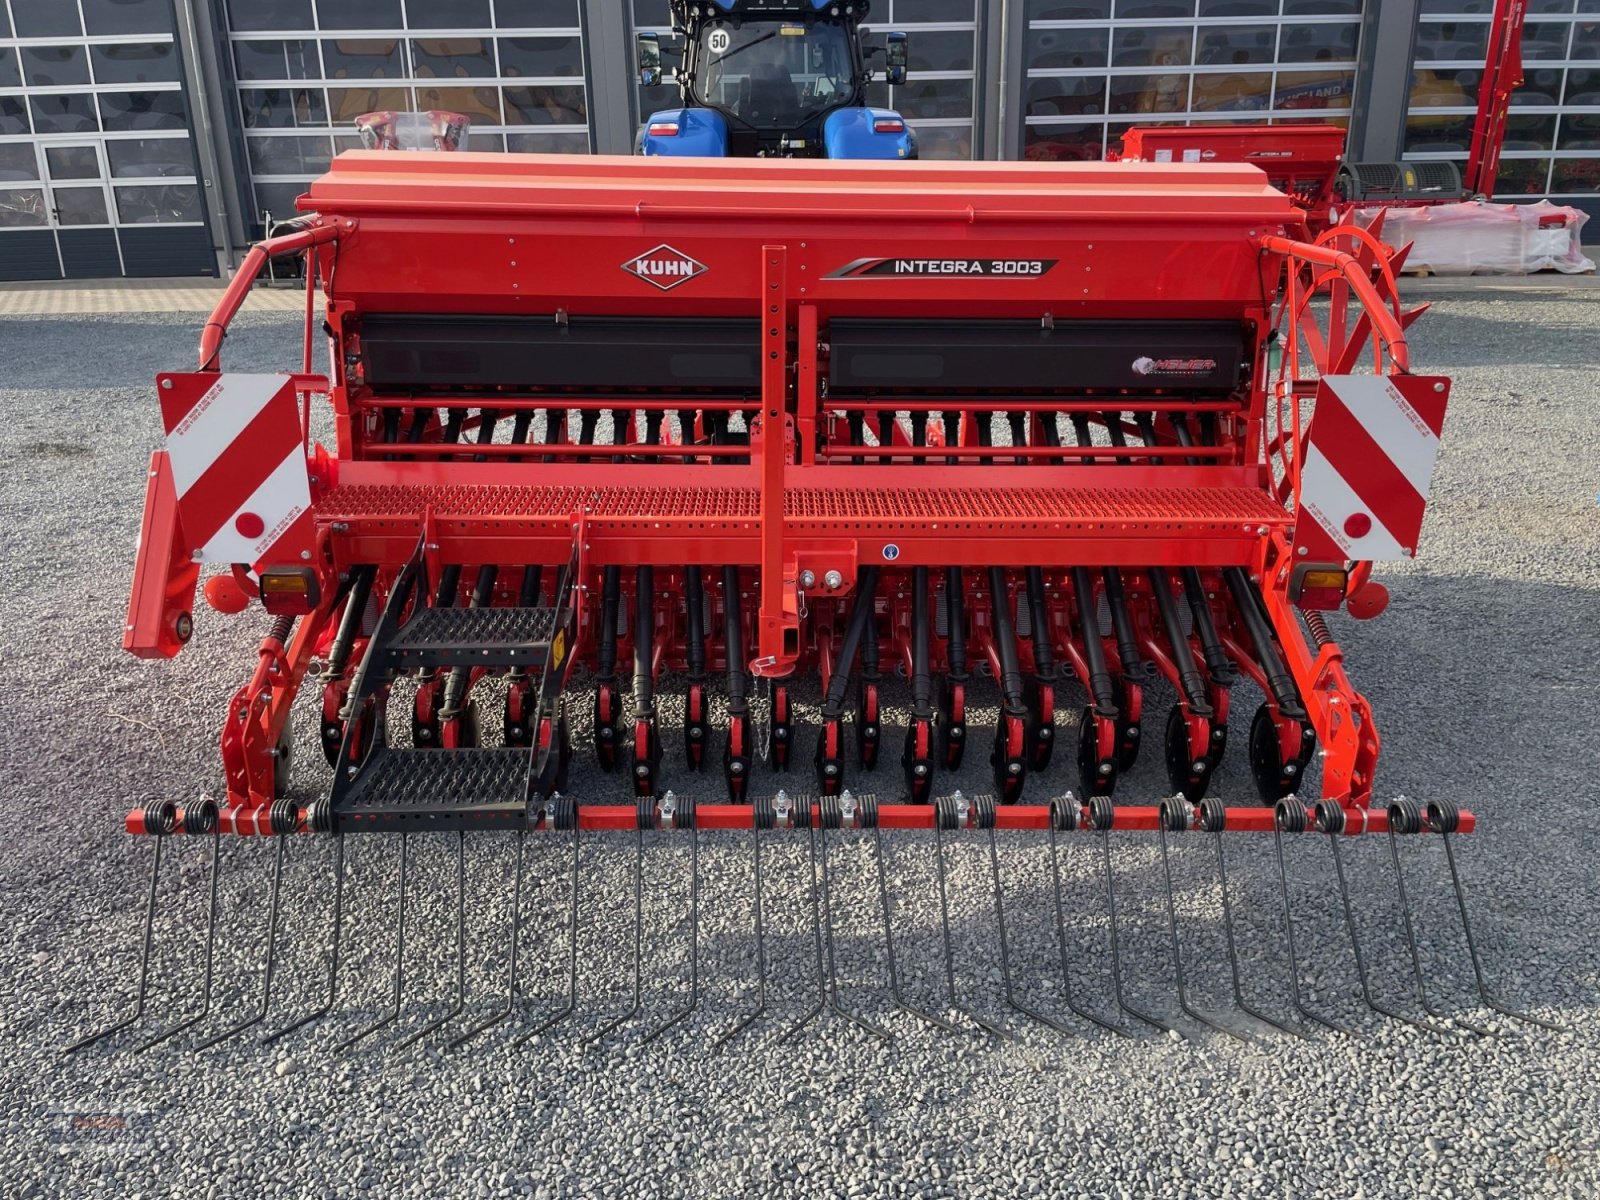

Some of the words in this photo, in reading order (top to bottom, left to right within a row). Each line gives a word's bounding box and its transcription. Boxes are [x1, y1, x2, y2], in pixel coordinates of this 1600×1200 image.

[712, 34, 727, 49] 50
[636, 260, 693, 275] KUHN
[895, 260, 983, 273] INTEGRA
[991, 261, 1042, 274] 3003
